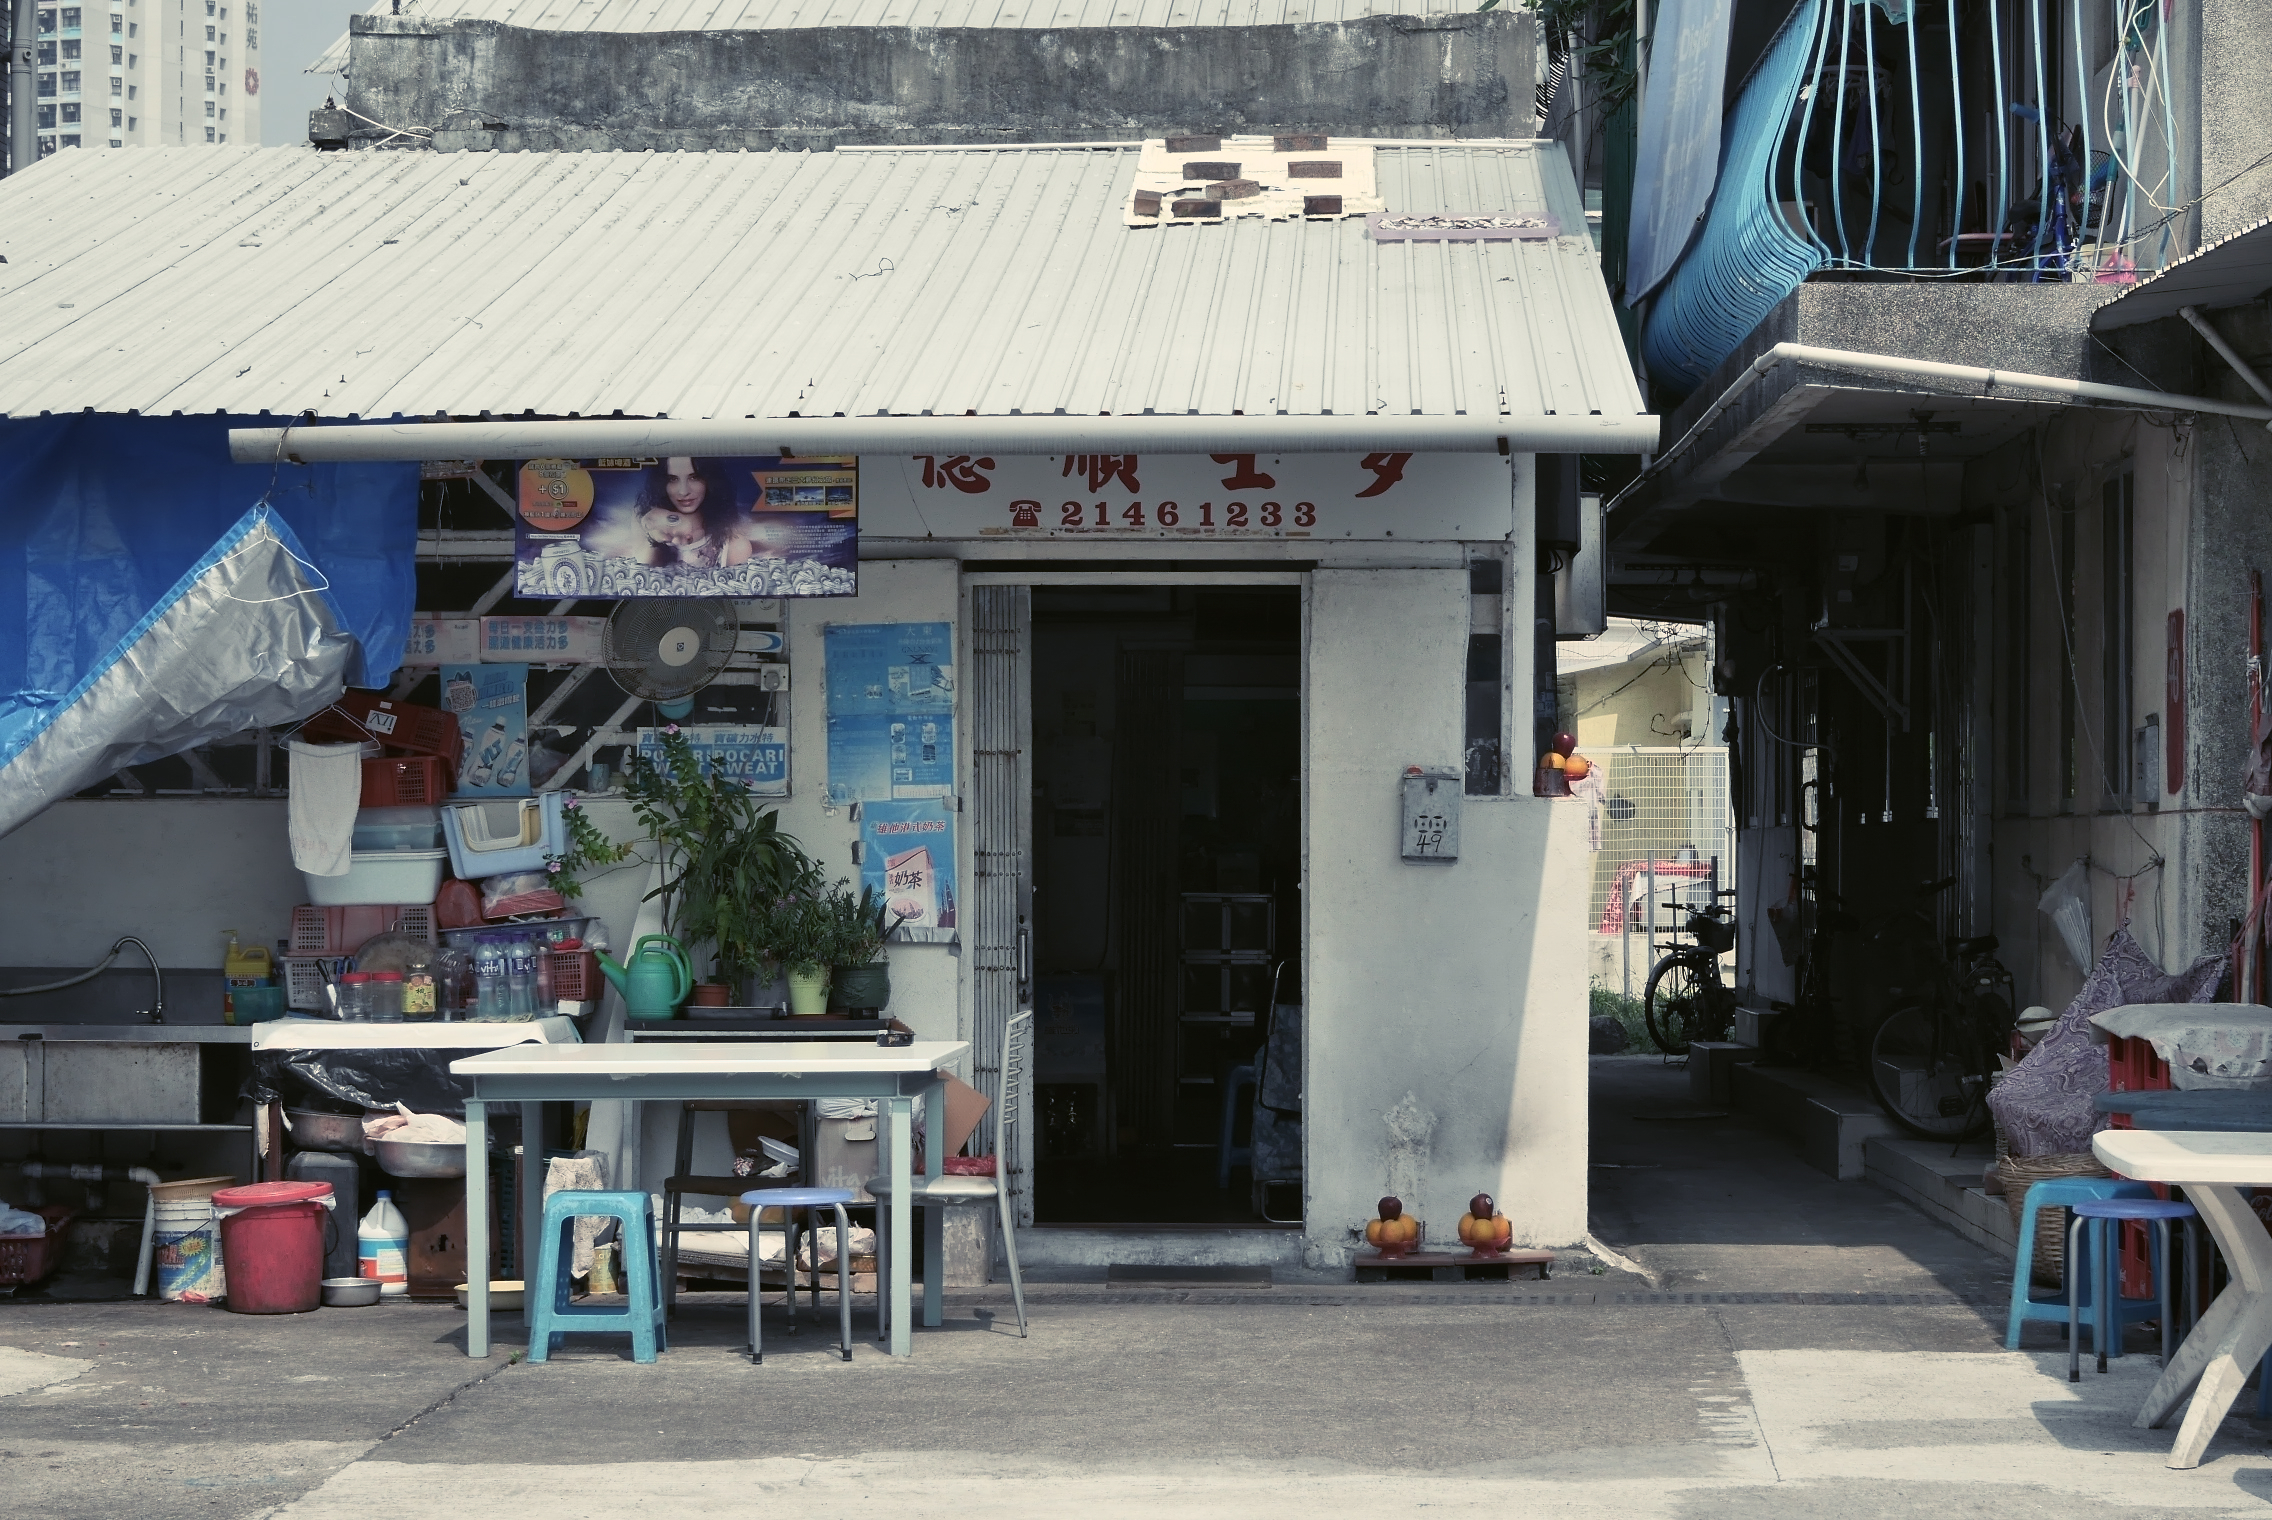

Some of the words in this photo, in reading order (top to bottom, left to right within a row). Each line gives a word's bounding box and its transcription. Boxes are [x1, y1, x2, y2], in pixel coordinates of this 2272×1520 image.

[551, 484, 565, 496] $1
[1061, 501, 1179, 527] 2146
[1199, 501, 1317, 528] 1233
[488, 620, 569, 635] 每日一支益力多
[642, 733, 701, 744] 寶水特
[641, 749, 711, 762] PORI
[714, 749, 784, 762] POCARI
[1416, 833, 1442, 854] 49
[894, 869, 923, 890] 奶茶
[821, 1165, 862, 1188] vita
